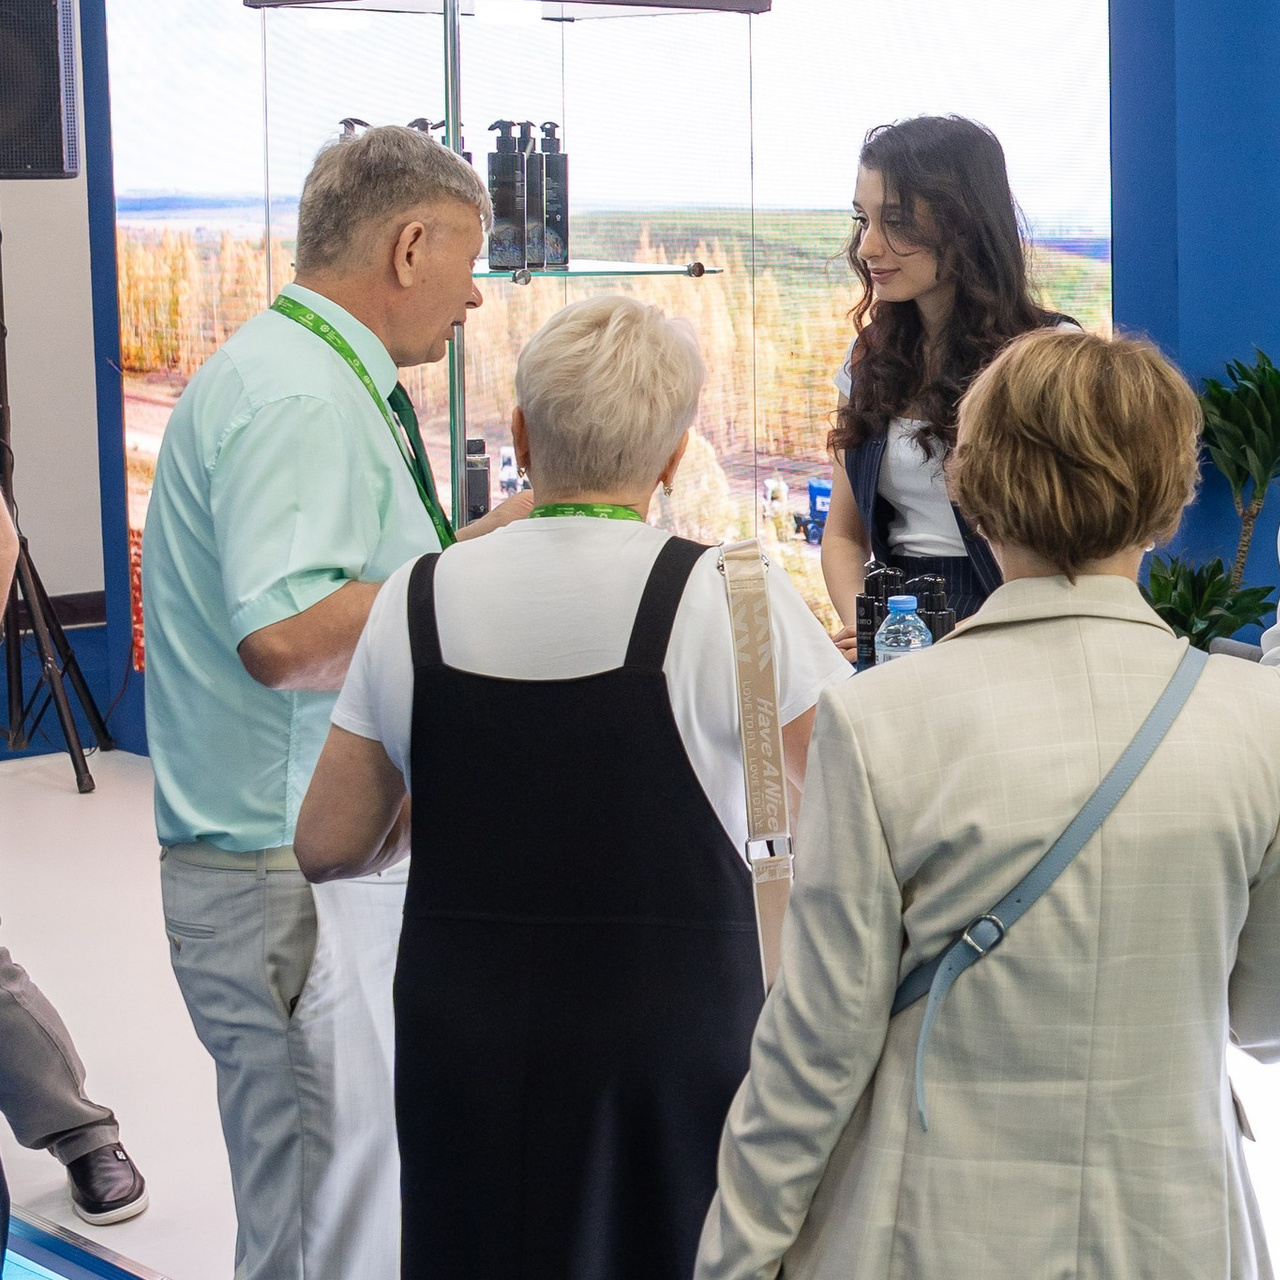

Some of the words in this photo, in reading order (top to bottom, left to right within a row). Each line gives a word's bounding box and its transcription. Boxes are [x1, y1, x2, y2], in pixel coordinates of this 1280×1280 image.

[742, 680, 753, 711] LOVE
[749, 757, 760, 786] LOVE
[757, 696, 775, 758] Have
[762, 759, 780, 777] A
[763, 778, 782, 832] Nice
